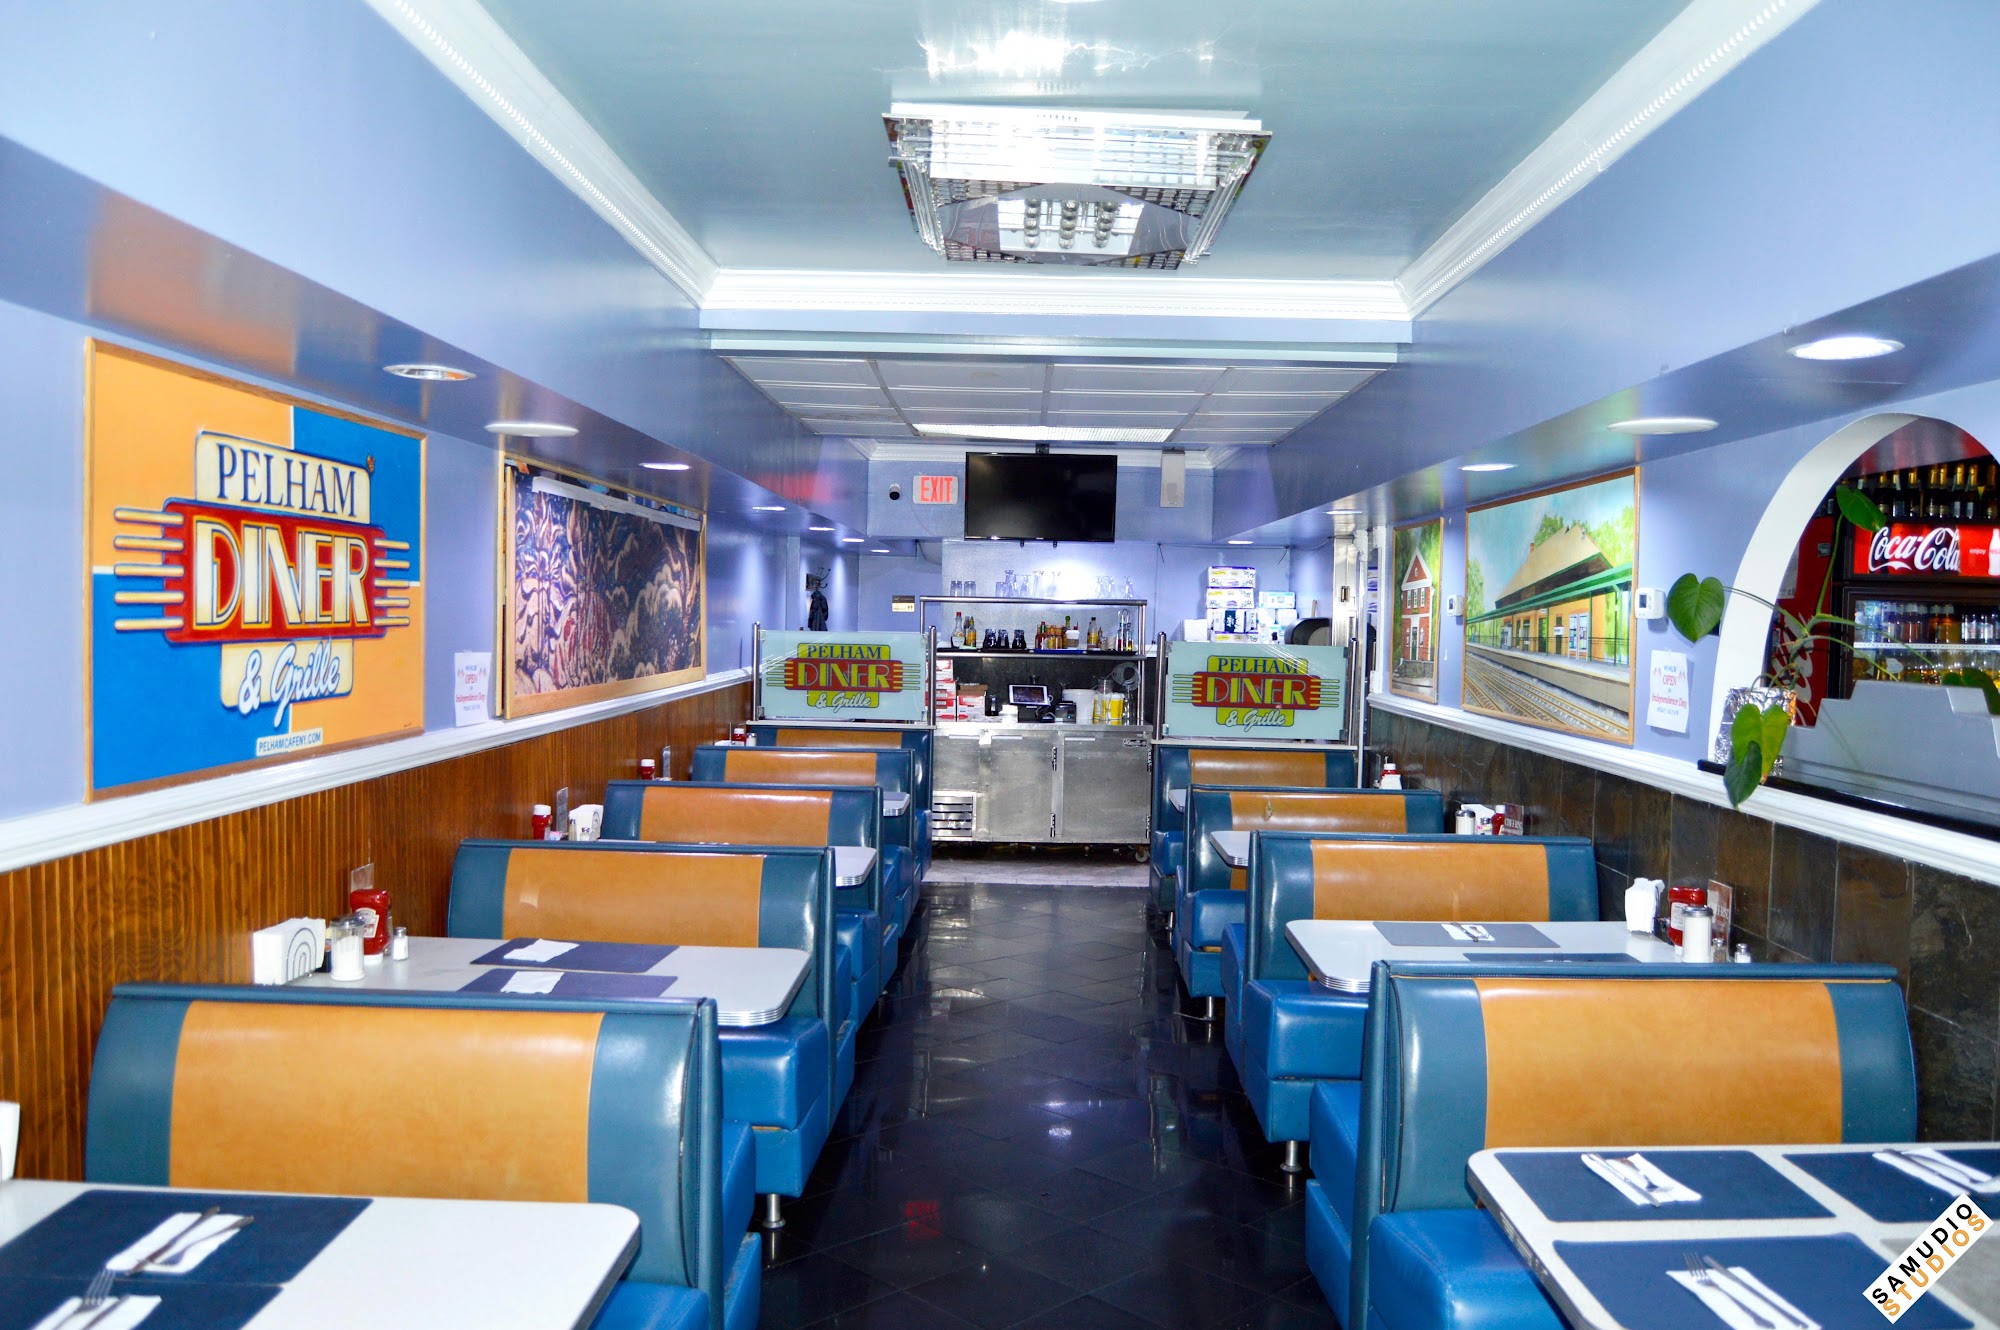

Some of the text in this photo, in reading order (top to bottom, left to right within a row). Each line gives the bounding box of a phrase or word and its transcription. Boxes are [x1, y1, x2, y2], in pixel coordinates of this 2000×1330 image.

[217, 443, 357, 517] PELHAM
[920, 476, 953, 502] EXIT
[1868, 526, 1960, 572] Coca-Cola
[194, 516, 370, 630] DINER
[807, 644, 882, 660] PELHAM
[797, 661, 890, 688] DINER
[1217, 657, 1299, 674] PELHAM
[238, 638, 341, 728] & Grille
[1206, 676, 1307, 705] DINER
[815, 691, 872, 713] & Grille
[1225, 708, 1286, 732] & Grille
[258, 731, 322, 753] PELHAMCAFENY.COM
